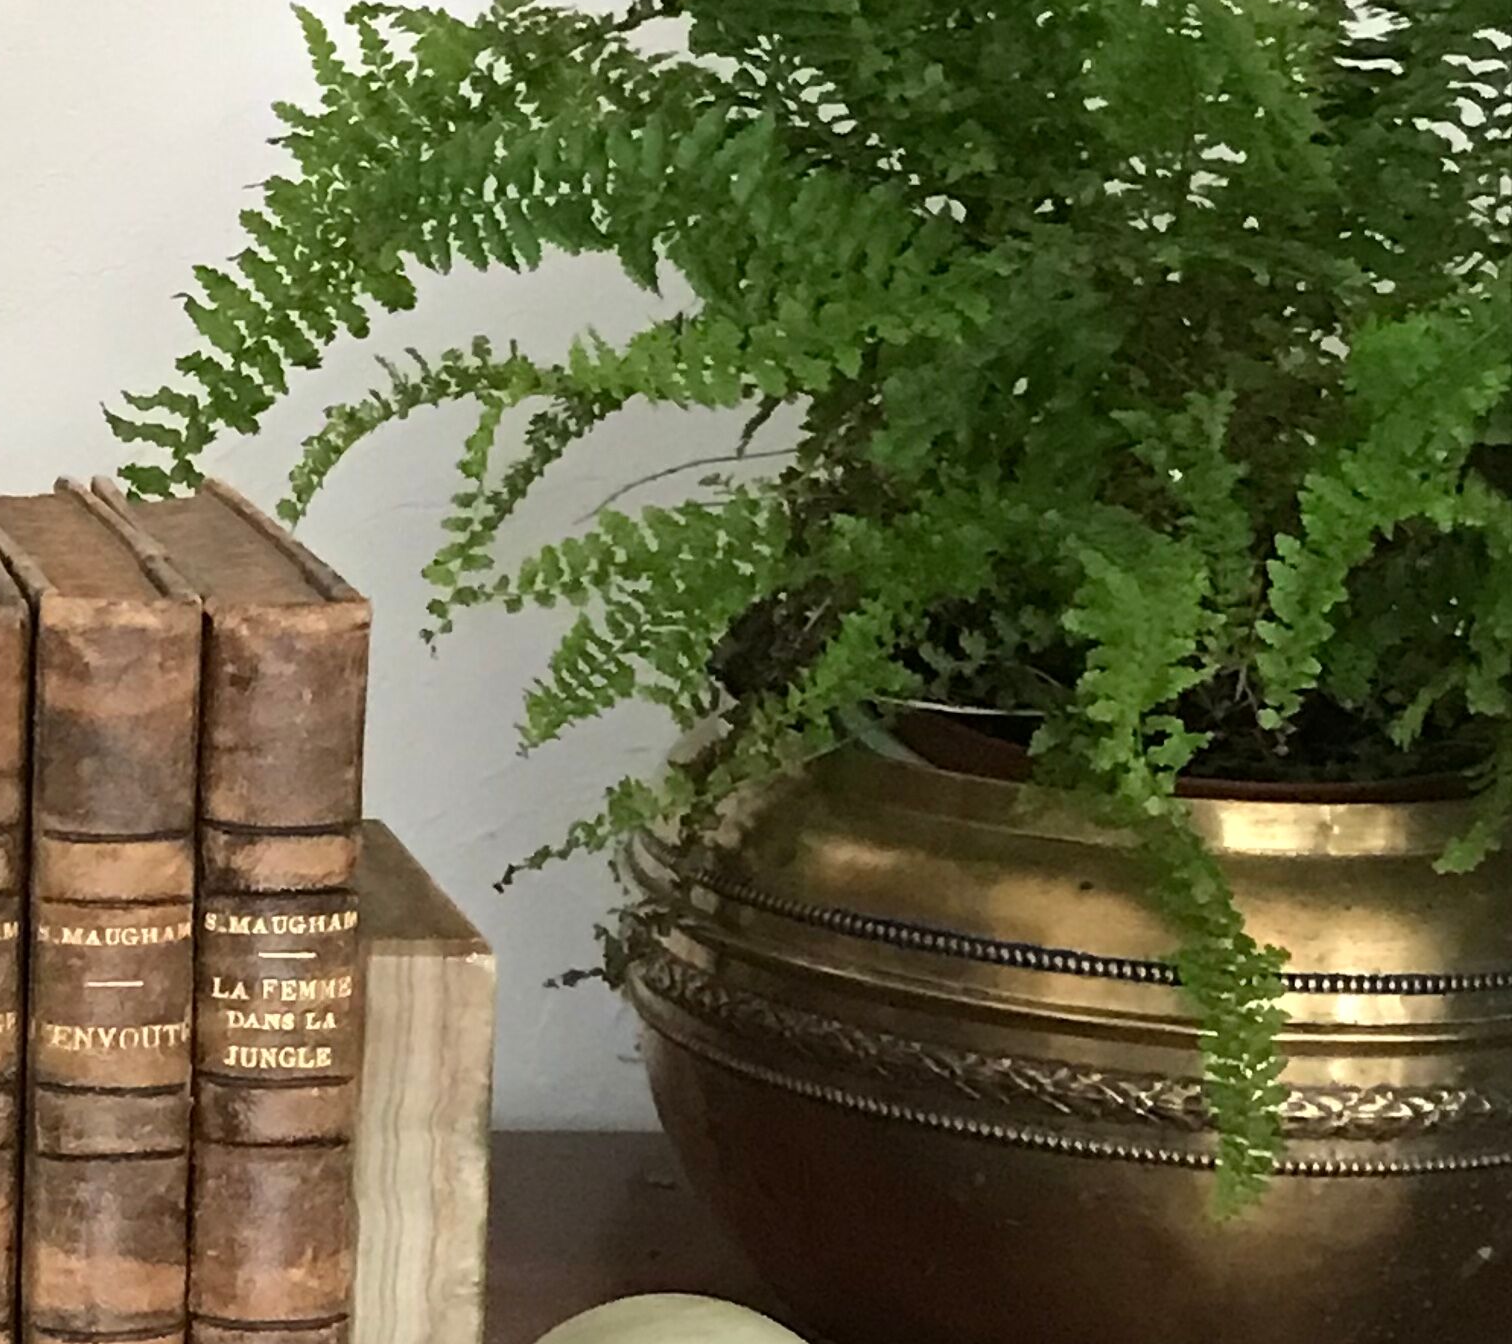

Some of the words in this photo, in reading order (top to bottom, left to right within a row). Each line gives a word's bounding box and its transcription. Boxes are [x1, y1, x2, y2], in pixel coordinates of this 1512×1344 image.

[211, 977, 251, 1000] LA
[262, 975, 353, 1001] FEMME
[226, 1010, 295, 1031] DANS
[305, 1011, 337, 1031] LA
[223, 1045, 332, 1069] JUNGLE
